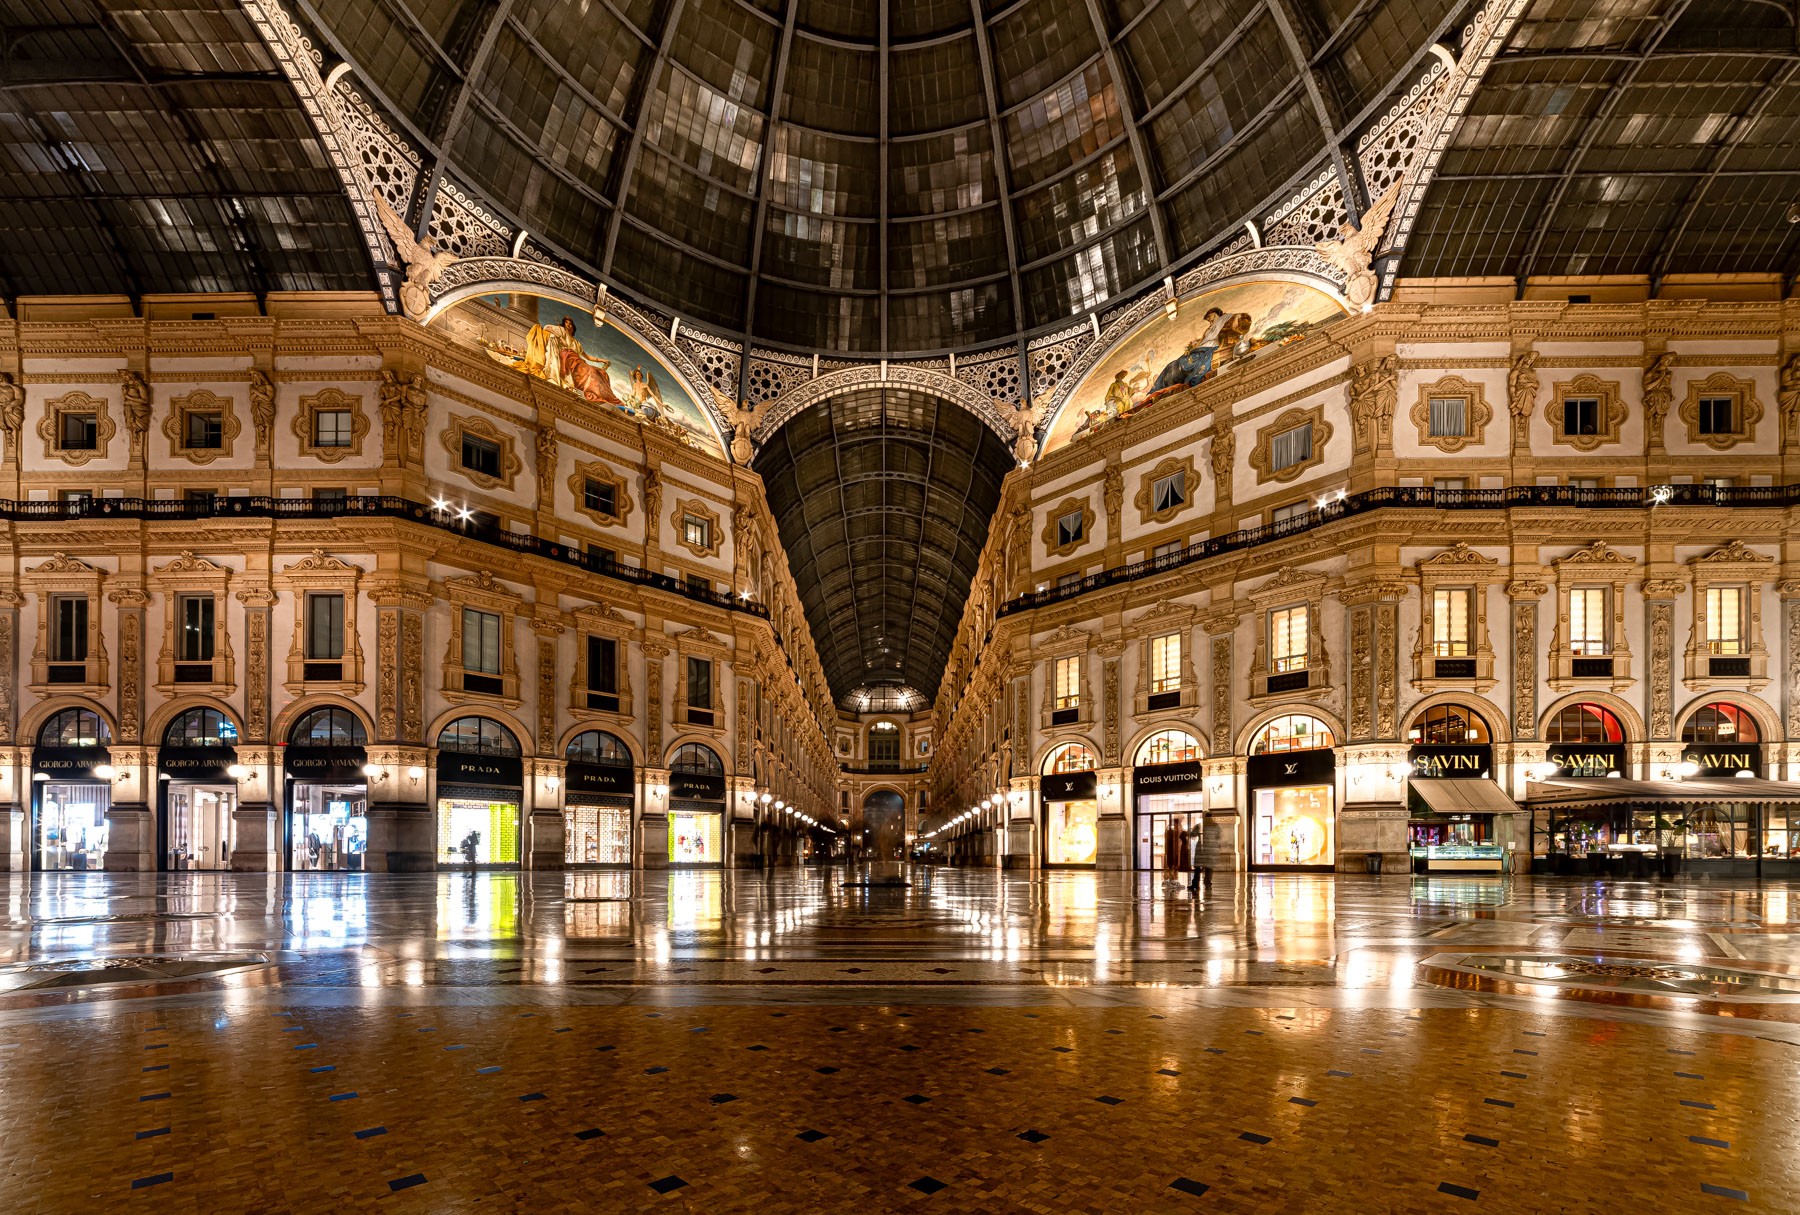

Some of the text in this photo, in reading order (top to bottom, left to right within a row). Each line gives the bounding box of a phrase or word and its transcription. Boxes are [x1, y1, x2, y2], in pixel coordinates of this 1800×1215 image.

[39, 760, 73, 769] GIORGIO
[165, 759, 232, 768] GIORGIO ARMANI
[293, 759, 360, 767] GIORGIO ARMANI
[1417, 754, 1480, 769] SAVINI
[1552, 754, 1615, 769] SAVINI
[1686, 753, 1750, 769] SAVINI
[460, 764, 501, 774] PRADA
[583, 775, 616, 783] PRADA
[1140, 773, 1198, 784] LOUIS VUITTON
